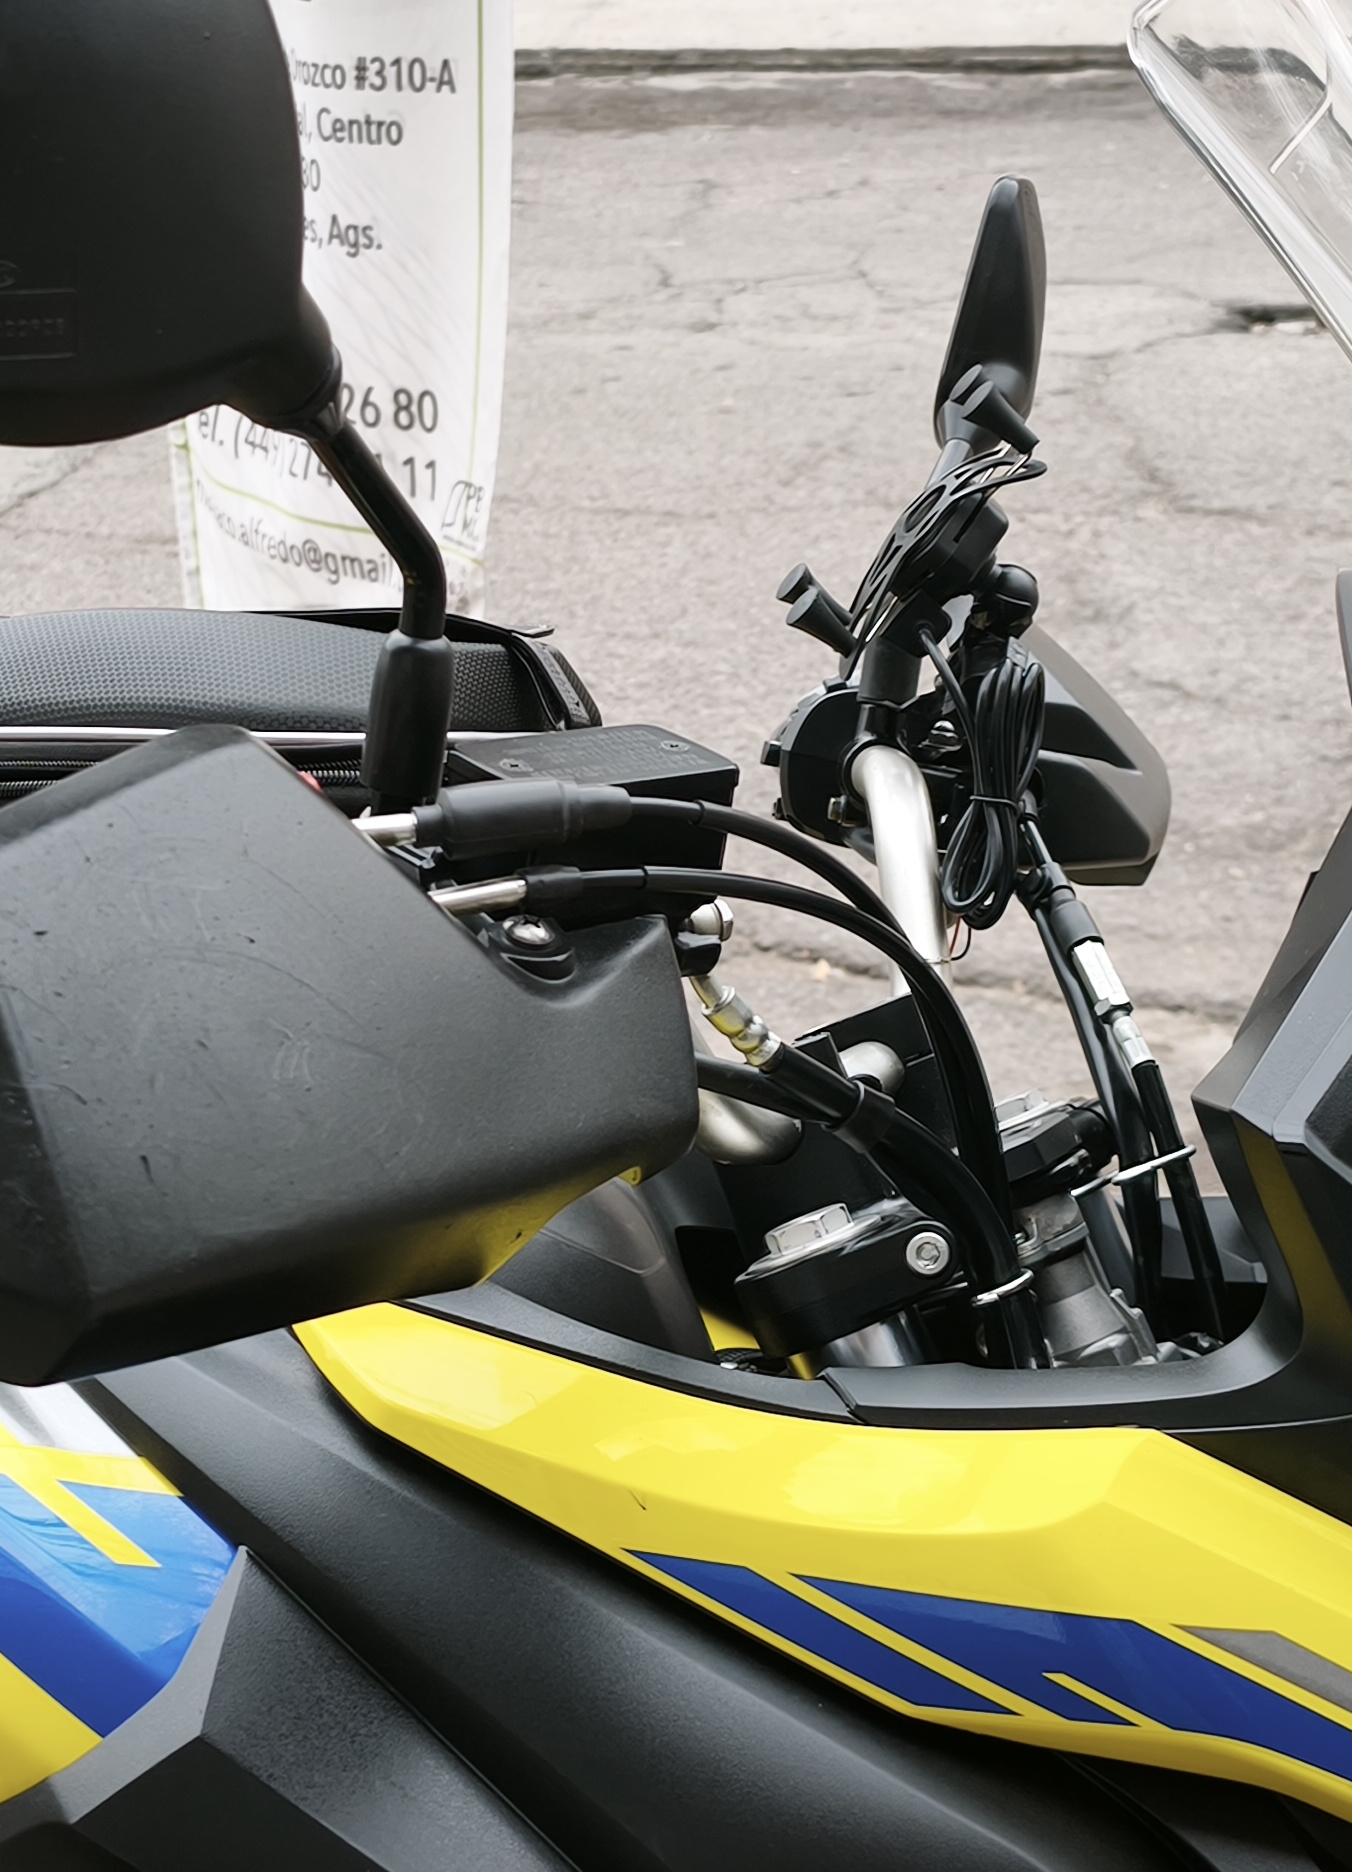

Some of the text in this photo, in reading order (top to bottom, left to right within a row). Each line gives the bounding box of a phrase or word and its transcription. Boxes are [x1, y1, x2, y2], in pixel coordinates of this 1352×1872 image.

[353, 56, 457, 95] #310-A
[316, 107, 404, 147] Centro
[327, 213, 383, 259] Ags.
[392, 387, 439, 434] 80
